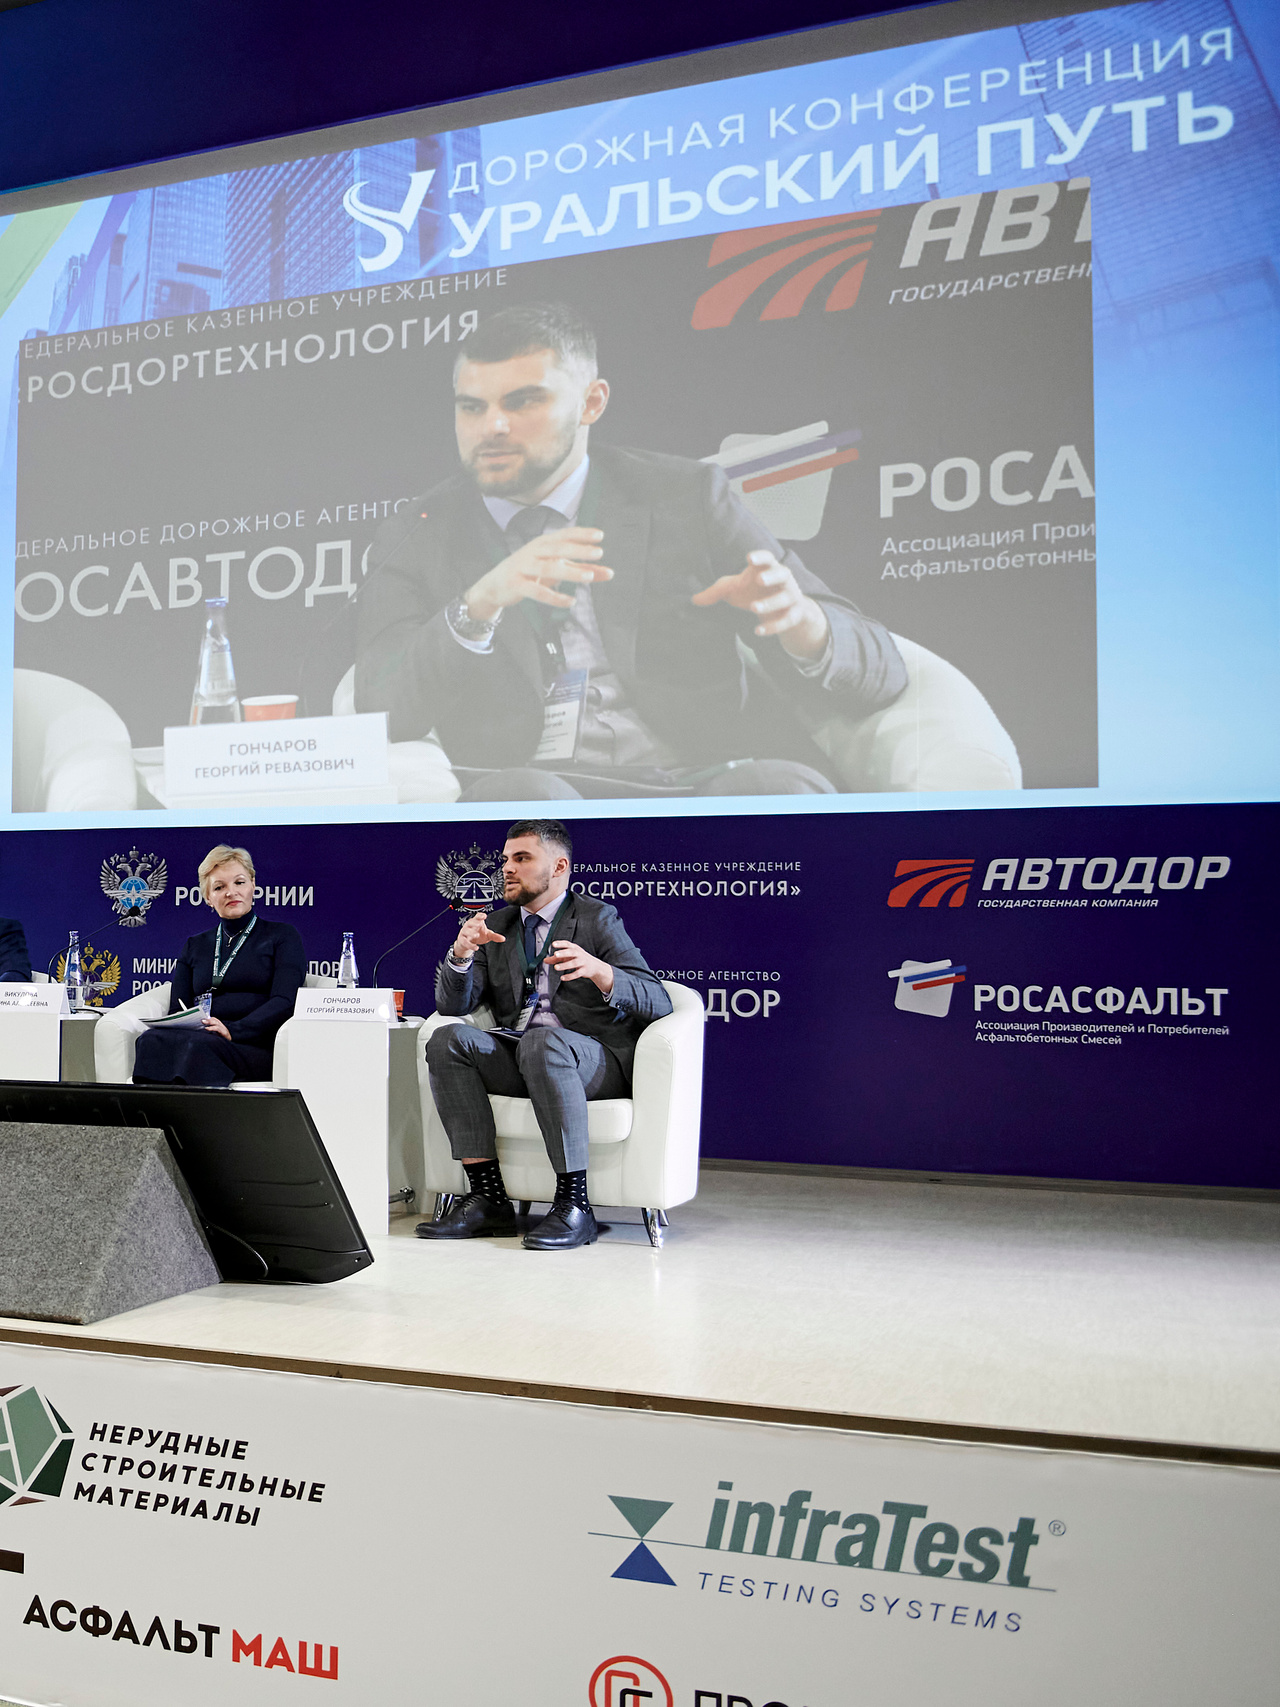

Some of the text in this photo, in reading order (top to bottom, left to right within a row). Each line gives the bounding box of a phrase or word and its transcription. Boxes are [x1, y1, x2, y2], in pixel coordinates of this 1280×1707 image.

[448, 27, 1234, 197] ДОРОЖНАЯ КОНФЕРЕНЦИЯ
[449, 90, 1235, 259] УРАЛЬСКИЙ ПУТЬ
[187, 295, 320, 335] КАЗЕННОЕ
[331, 267, 508, 309] УЧРЕЖДЕНИЕ
[879, 445, 1095, 518] РОСА
[160, 509, 305, 545] ДОРОЖНОЕ
[881, 522, 1095, 557] Ассоциация Прои
[14, 540, 373, 624] ОСАВТОД
[229, 738, 318, 756] ГОНЧАРОВ
[195, 758, 355, 780] ГЕОРГИЙ РЕВАЗОВИЧ
[570, 861, 802, 874] ЕРАЛЬНОЕ КАЗЕННОЕ УЧРЕЖДЕНИЕ
[981, 856, 1231, 894] АВТОДОР
[175, 886, 314, 906] РОРНИИ
[977, 898, 1159, 908] ГОСУДАРСТВЕННАЯ КОМПАНИЯ
[708, 970, 781, 981] АГЕНТСТВО
[306, 1006, 335, 1014] ГЕОРГИЙ
[691, 988, 781, 1022] ДОР
[973, 984, 1229, 1016] РОСАСФАЛЬТ
[975, 1019, 1229, 1036] Ассоциация Производителей и Потребителей
[975, 1030, 1122, 1045] Асфальтобетонных Смесей
[88, 1422, 249, 1461] НЕРУДНЫЕ
[81, 1452, 326, 1504] СТРОИТЕЛЬНЫЕ
[73, 1482, 261, 1527] МАТЕРИАЛЫ
[705, 1480, 1040, 1588] infraTest
[698, 1572, 1022, 1632] TESTING SYSTEMS
[23, 1594, 339, 1681] АСФАЛЬТ МАШ
